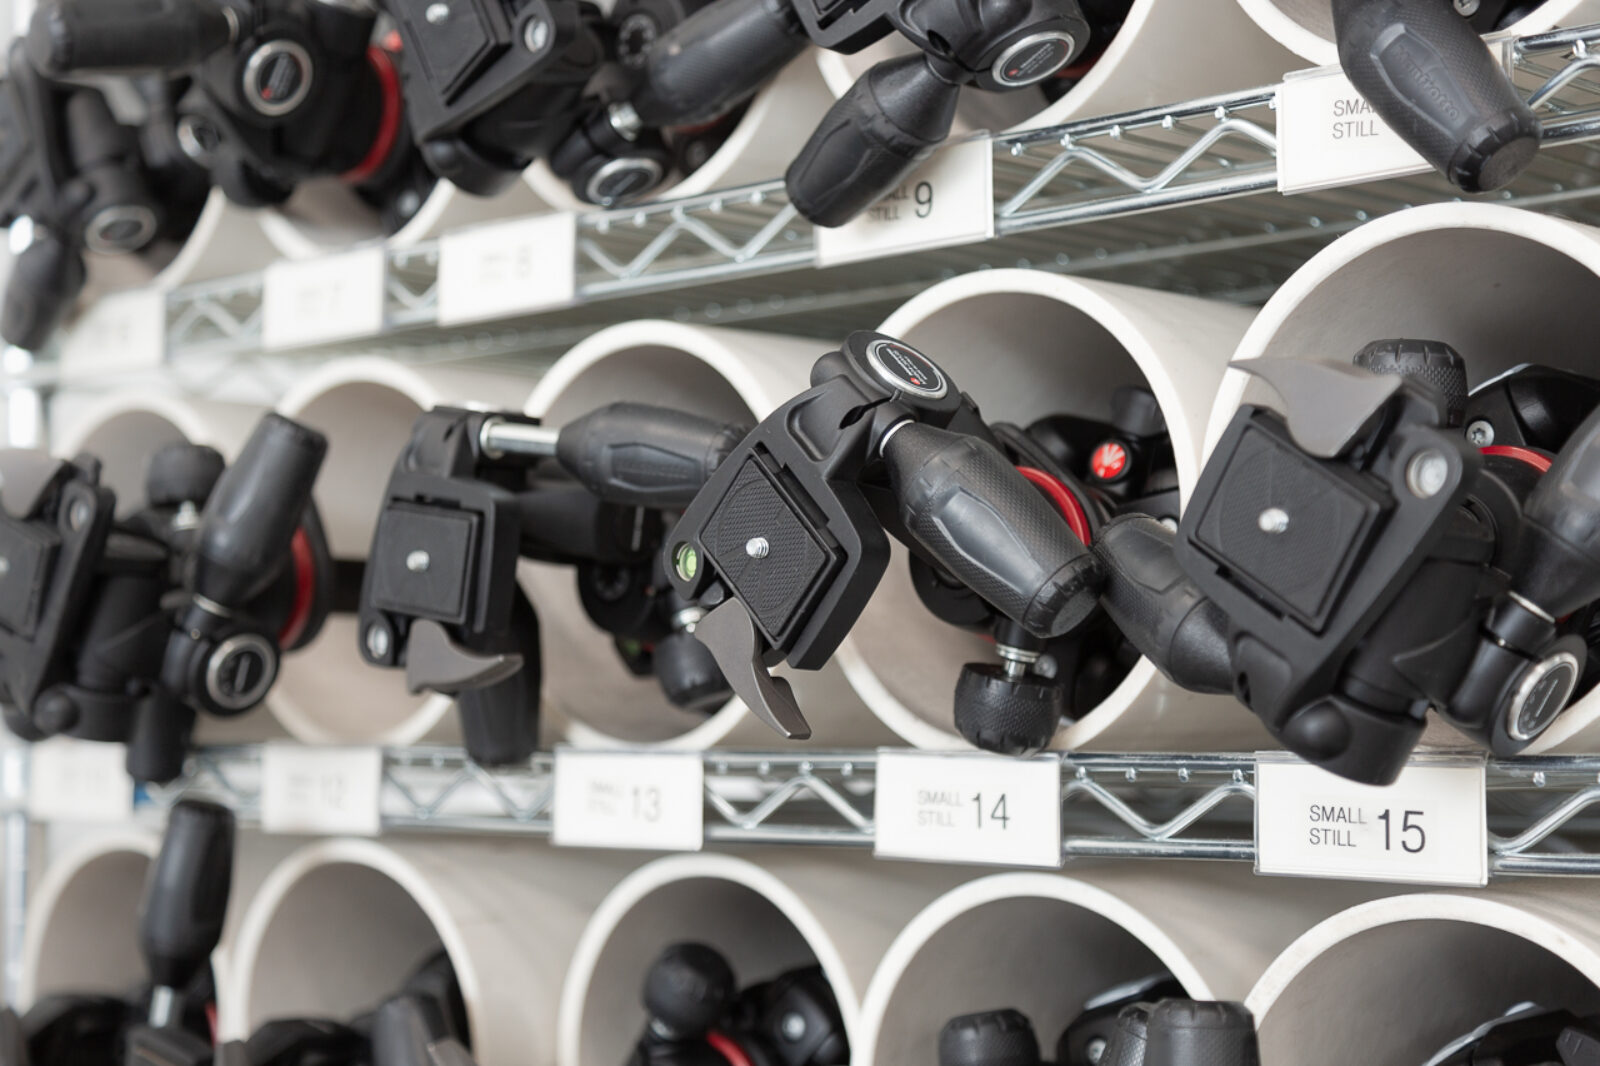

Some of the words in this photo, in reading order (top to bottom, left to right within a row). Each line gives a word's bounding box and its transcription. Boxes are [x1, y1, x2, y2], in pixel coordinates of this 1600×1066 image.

[1333, 98, 1376, 117] SMA
[1332, 119, 1379, 140] STILL
[914, 181, 933, 219] 9
[631, 786, 662, 822] 13
[917, 789, 964, 807] SMALL
[917, 809, 955, 828] STILL
[971, 792, 1011, 830] 14
[1309, 804, 1367, 824] SMALL
[1309, 827, 1357, 847] STILL
[1378, 808, 1426, 853] 15
